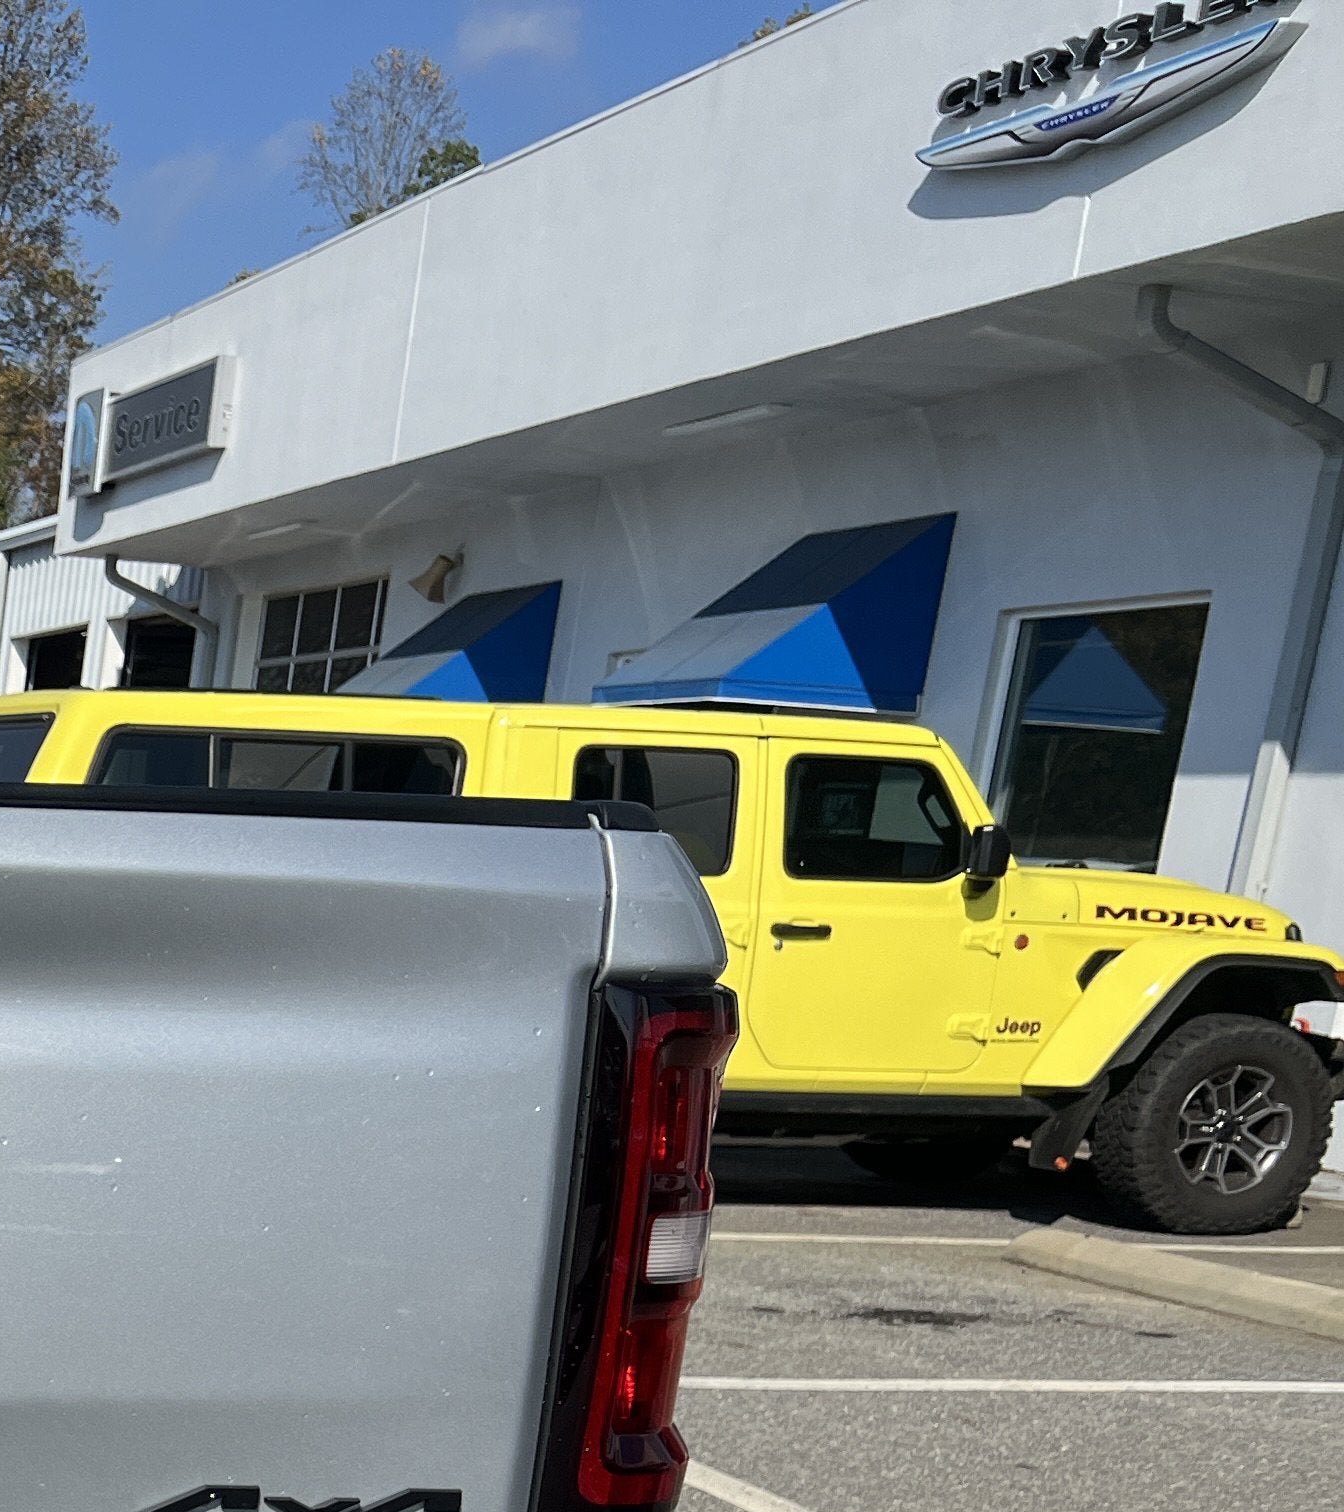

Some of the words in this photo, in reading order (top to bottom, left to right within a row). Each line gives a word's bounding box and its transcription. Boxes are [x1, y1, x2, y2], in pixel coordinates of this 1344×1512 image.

[937, 0, 1278, 116] CHRYSLE
[115, 396, 200, 454] Service
[1095, 905, 1267, 932] MOJAVE
[996, 1016, 1041, 1036] Jeep
